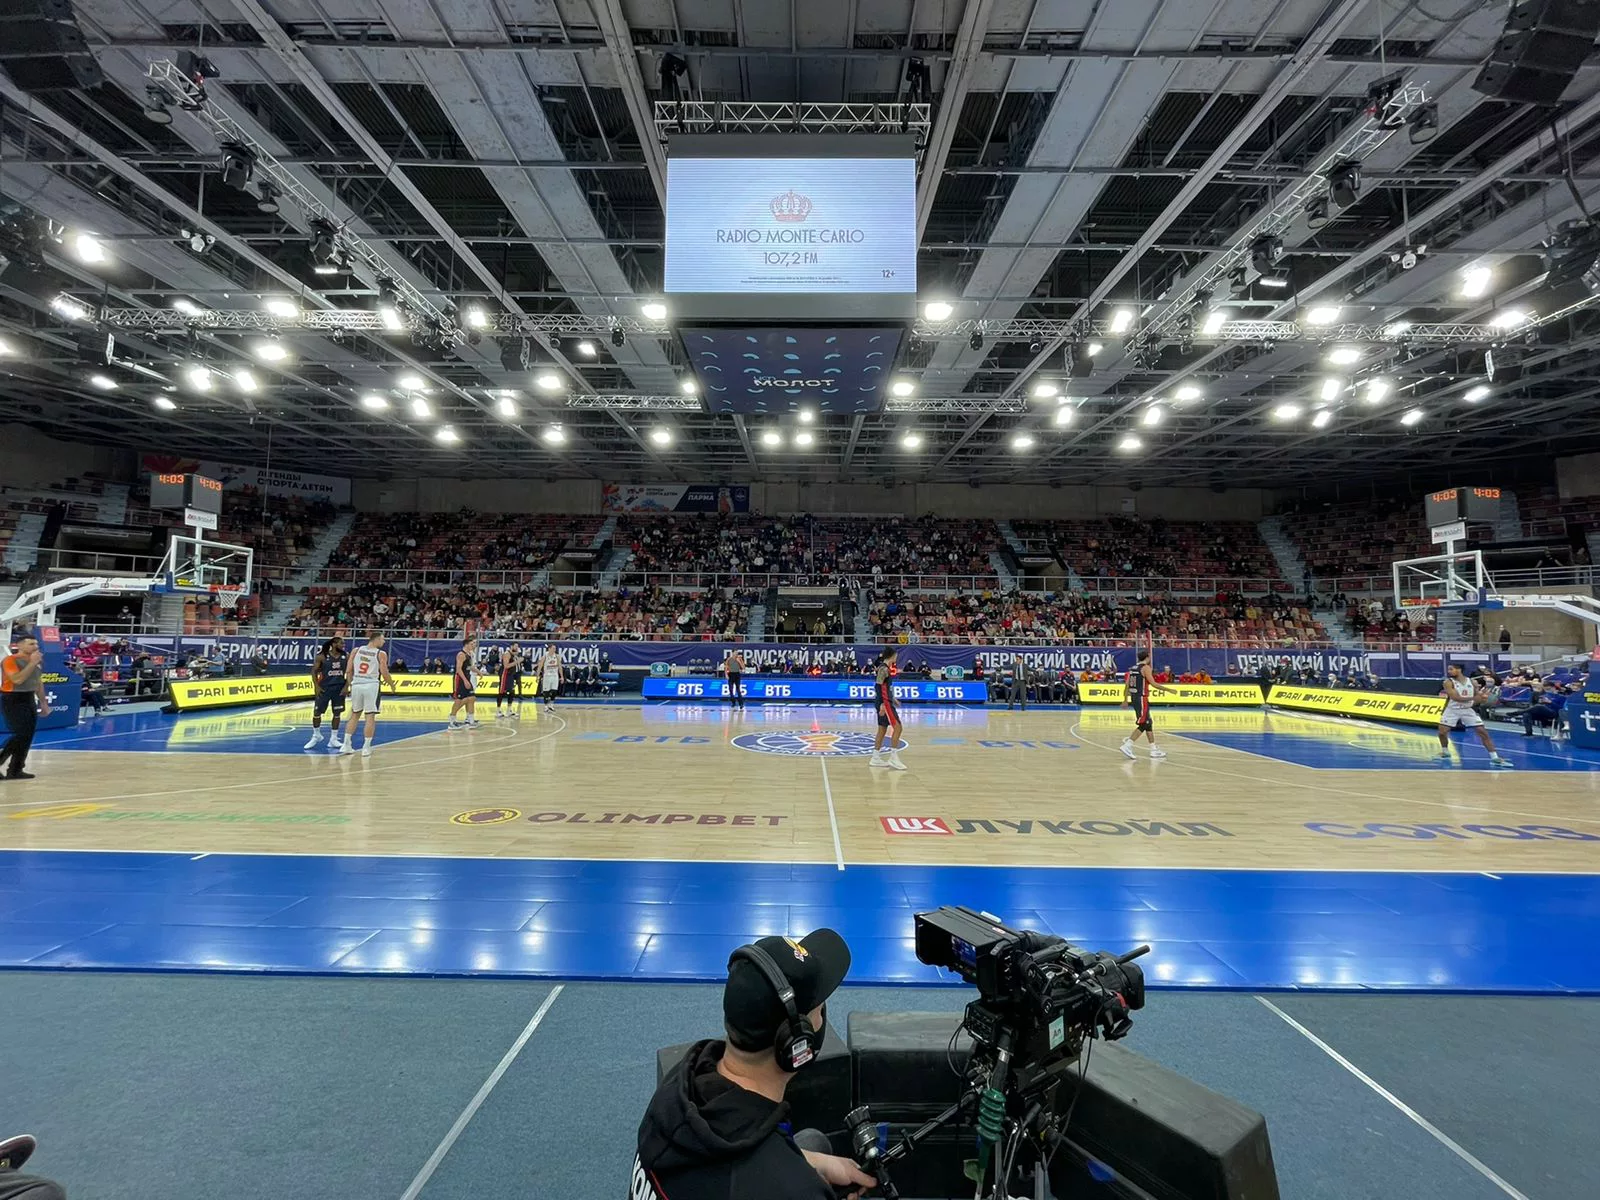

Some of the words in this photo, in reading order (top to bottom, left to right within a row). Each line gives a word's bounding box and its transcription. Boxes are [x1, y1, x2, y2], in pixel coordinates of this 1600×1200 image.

[716, 229, 761, 243] RADIO
[766, 229, 816, 243] MONTE
[820, 229, 864, 243] CARLO
[763, 252, 801, 267] 107,2
[804, 252, 818, 264] FM
[881, 269, 895, 278] 12+
[159, 474, 184, 484] 4:03
[199, 478, 222, 491] 4:03
[301, 483, 333, 493] ДЕТЯМ
[1473, 487, 1500, 499] 4:03
[1432, 489, 1457, 502] 4:03
[559, 644, 600, 664] КРАЙ
[1071, 650, 1112, 669] КРАЙ
[359, 662, 369, 675] 9
[196, 687, 225, 697] PARI
[235, 684, 273, 695] MATCH
[292, 681, 313, 691] PARI
[677, 683, 703, 695] ВТБ
[765, 684, 791, 697] ВТБ
[850, 686, 876, 698] ВТБ
[893, 686, 919, 698] ВТБ
[937, 687, 963, 698] ВТБ
[1095, 689, 1119, 697] PARI
[1186, 690, 1211, 698] PARI
[1220, 690, 1257, 699] MATCH
[1281, 692, 1302, 701] PARI
[1308, 693, 1343, 705] MATCH
[1361, 698, 1391, 710] PARI
[613, 735, 712, 743] ВТБ
[976, 740, 1081, 748] ВТБ
[527, 812, 789, 826] OLIMPBET
[955, 817, 1235, 837] ЛУКОЙЛ
